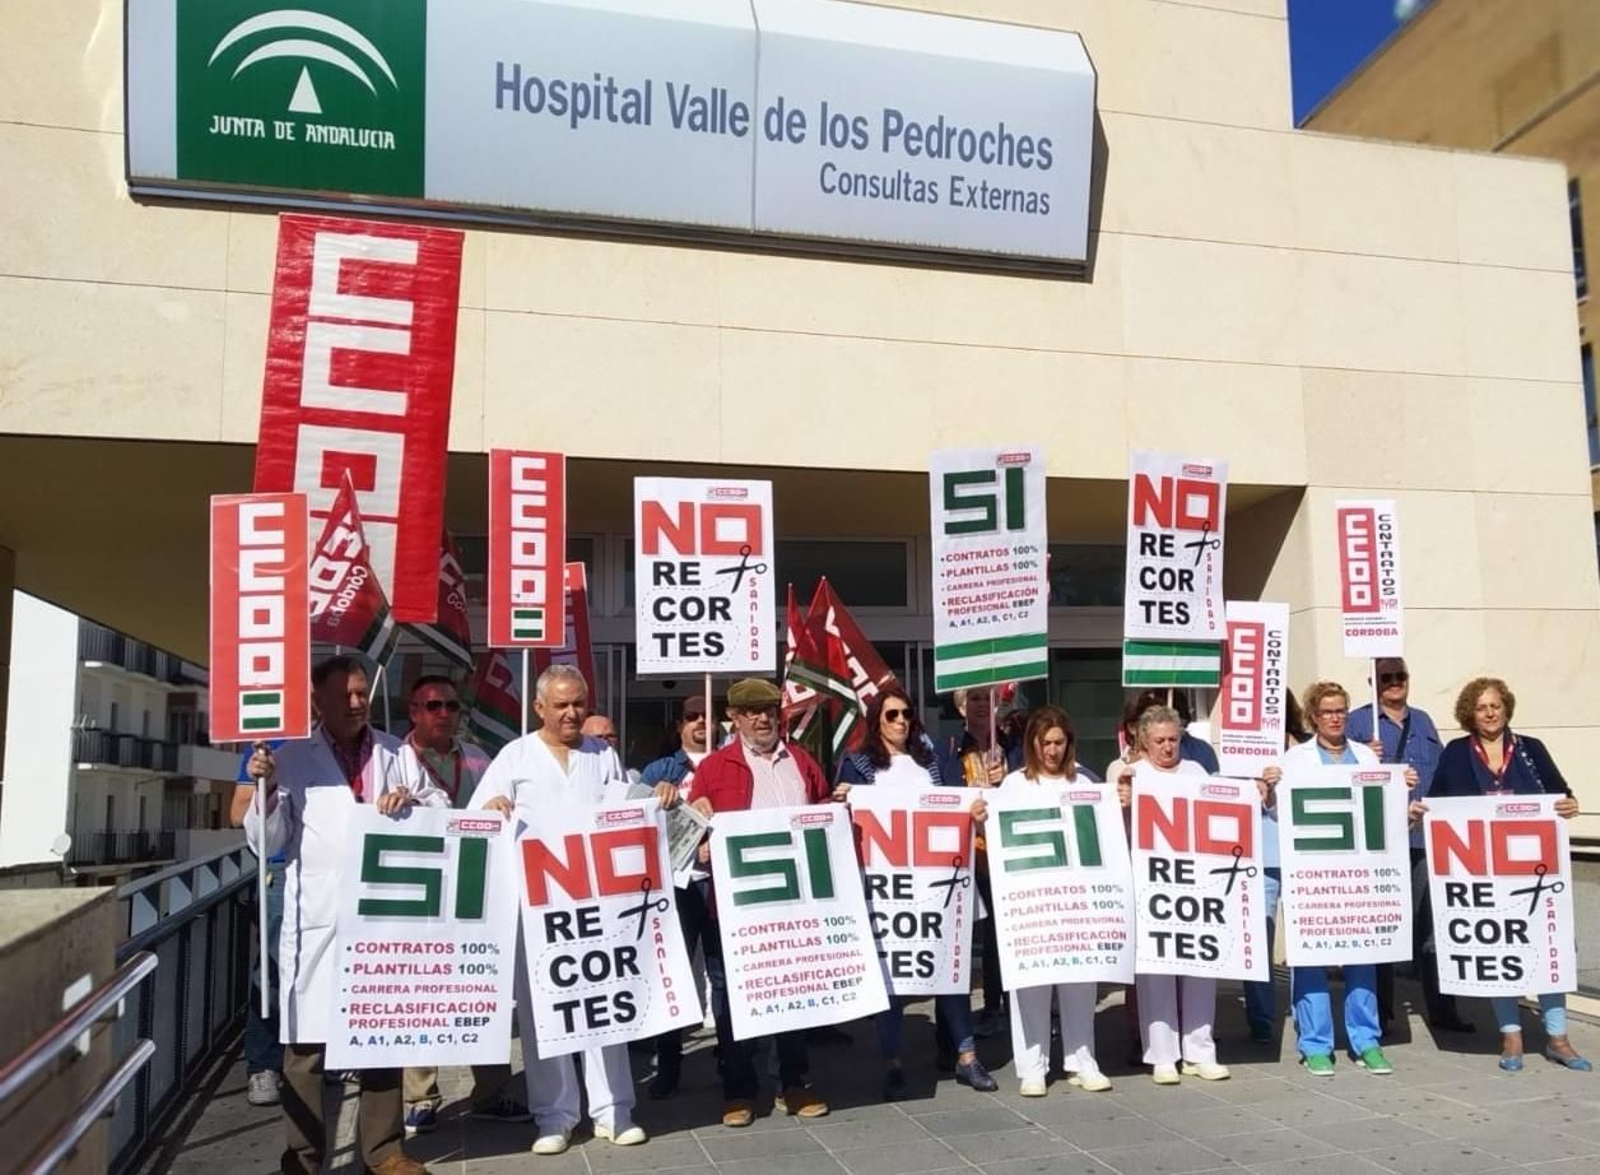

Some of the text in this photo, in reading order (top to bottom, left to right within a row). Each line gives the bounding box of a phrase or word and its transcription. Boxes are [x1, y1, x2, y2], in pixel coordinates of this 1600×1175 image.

[495, 61, 1054, 171] Hospital Valle de los Pedroches
[209, 115, 396, 150] JUNTA DE ANDALUCIA
[820, 161, 1051, 215] Consultas Externas
[944, 466, 1025, 535] SI
[1134, 474, 1220, 532] NO
[511, 456, 547, 604] CCOO
[642, 500, 763, 556] NO
[946, 545, 1038, 562] CONTRATOS 100%
[1139, 532, 1175, 557] RE
[1378, 513, 1396, 596] CONTRATOS
[652, 561, 702, 587] RE
[947, 560, 1038, 577] PLANTILLAS 100%
[1345, 514, 1371, 607] CCOO
[1139, 567, 1195, 592] COR
[1206, 552, 1215, 630] SANIDAD
[238, 502, 285, 686] CCOO
[947, 599, 1035, 616] PROFESIONAL EBEP
[652, 596, 732, 622] COR
[749, 577, 759, 661] SANIDAD
[1139, 601, 1191, 625] TES
[652, 632, 725, 657] TES
[1345, 627, 1398, 637] CORDOBA
[1230, 628, 1256, 724] CCOO
[1264, 630, 1282, 714] CONTRATOS
[1222, 746, 1278, 756] CORDOBA
[1138, 794, 1253, 858] NO
[1291, 786, 1385, 851] SI
[854, 810, 972, 867] NO
[998, 805, 1102, 873] SI
[1430, 820, 1560, 876] NO
[357, 833, 488, 919] SI
[521, 826, 663, 907] NO
[726, 828, 835, 906] SI
[1148, 857, 1196, 885] RE
[1296, 868, 1401, 879] CONTRATOS 100%
[866, 874, 914, 900] RE
[1009, 884, 1123, 901] CONTRATOS 100%
[1297, 884, 1401, 895] PLANTILLAS 100%
[1445, 882, 1494, 907] RE
[1010, 900, 1124, 917] PLANTILLAS 100%
[1148, 893, 1226, 924] COR
[544, 906, 603, 943] RE
[738, 915, 856, 937] CONTRATOS 100%
[870, 911, 943, 940] COR
[953, 891, 963, 983] SANIDAD
[1014, 928, 1126, 947] RECLASIFICACIÓN
[1240, 881, 1252, 970] SANIDAD
[1300, 925, 1399, 936] PROFESIONAL EBEP
[1449, 919, 1529, 944] COR
[355, 942, 500, 954] CONTRATOS 100%
[741, 933, 859, 955] PLANTILLAS 100%
[1015, 942, 1123, 957] PROFESIONAL EBEP
[1148, 932, 1220, 962] TES
[1546, 897, 1559, 983] SANIDAD
[353, 963, 498, 975] PLANTILLAS 100%
[549, 946, 641, 988] COR
[652, 917, 680, 1017] SANIDAD
[743, 949, 863, 972] CARRERA PROFESIONAL
[1450, 955, 1524, 981] TES
[351, 984, 498, 994] CARRERA PROFESIONAL
[746, 976, 863, 1002] PROFESIONAL EBEP
[349, 1000, 497, 1015] RECLASIFICACIÓN
[553, 990, 637, 1034] TES
[348, 1016, 490, 1028] PROFESIONAL EBEP
[349, 1033, 478, 1046] A, A1, A2, B, C1, C2
